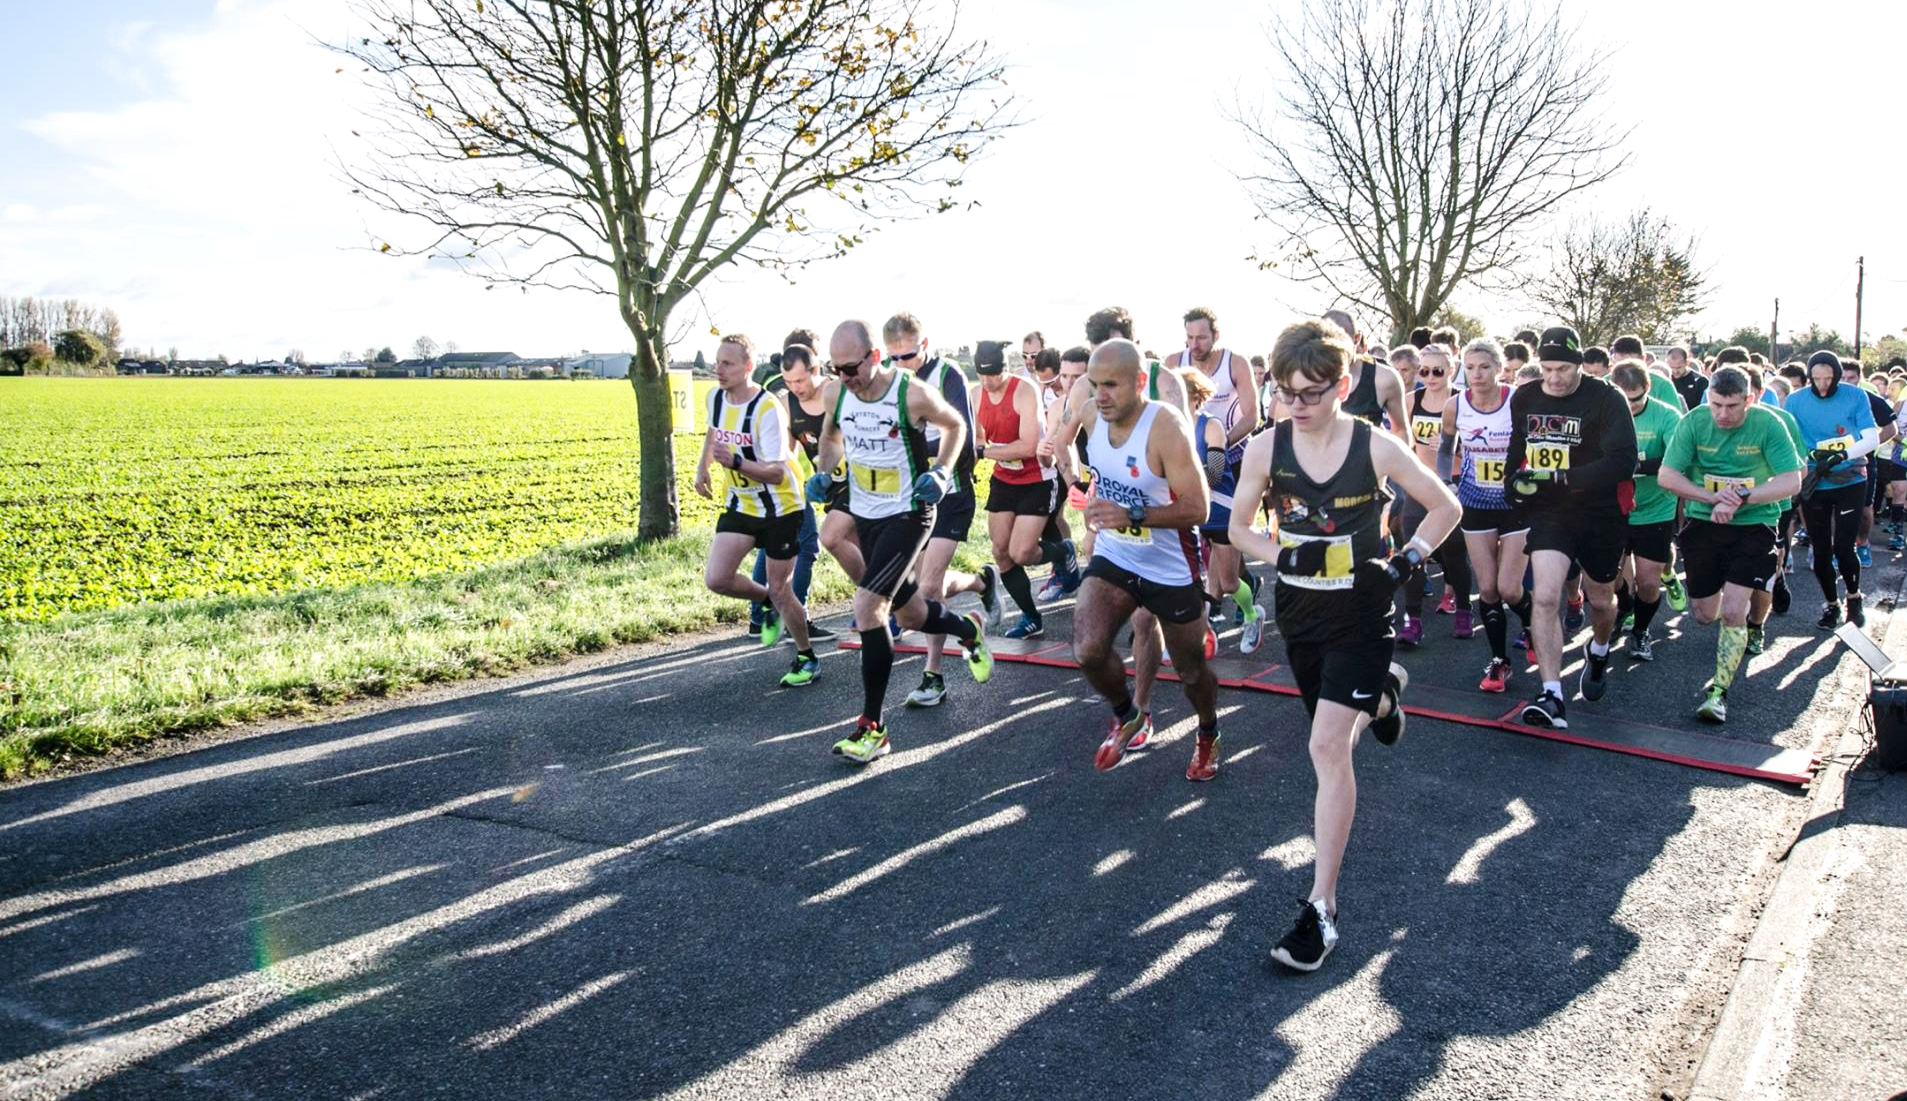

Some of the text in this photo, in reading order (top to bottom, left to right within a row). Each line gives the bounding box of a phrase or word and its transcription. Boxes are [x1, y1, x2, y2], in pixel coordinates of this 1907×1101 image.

[715, 429, 753, 446] OSTON
[847, 434, 888, 452] MATT
[1531, 448, 1563, 470] 189
[871, 469, 876, 491] 1
[1102, 477, 1149, 498] ROYAL
[1104, 489, 1150, 508] FORCE
